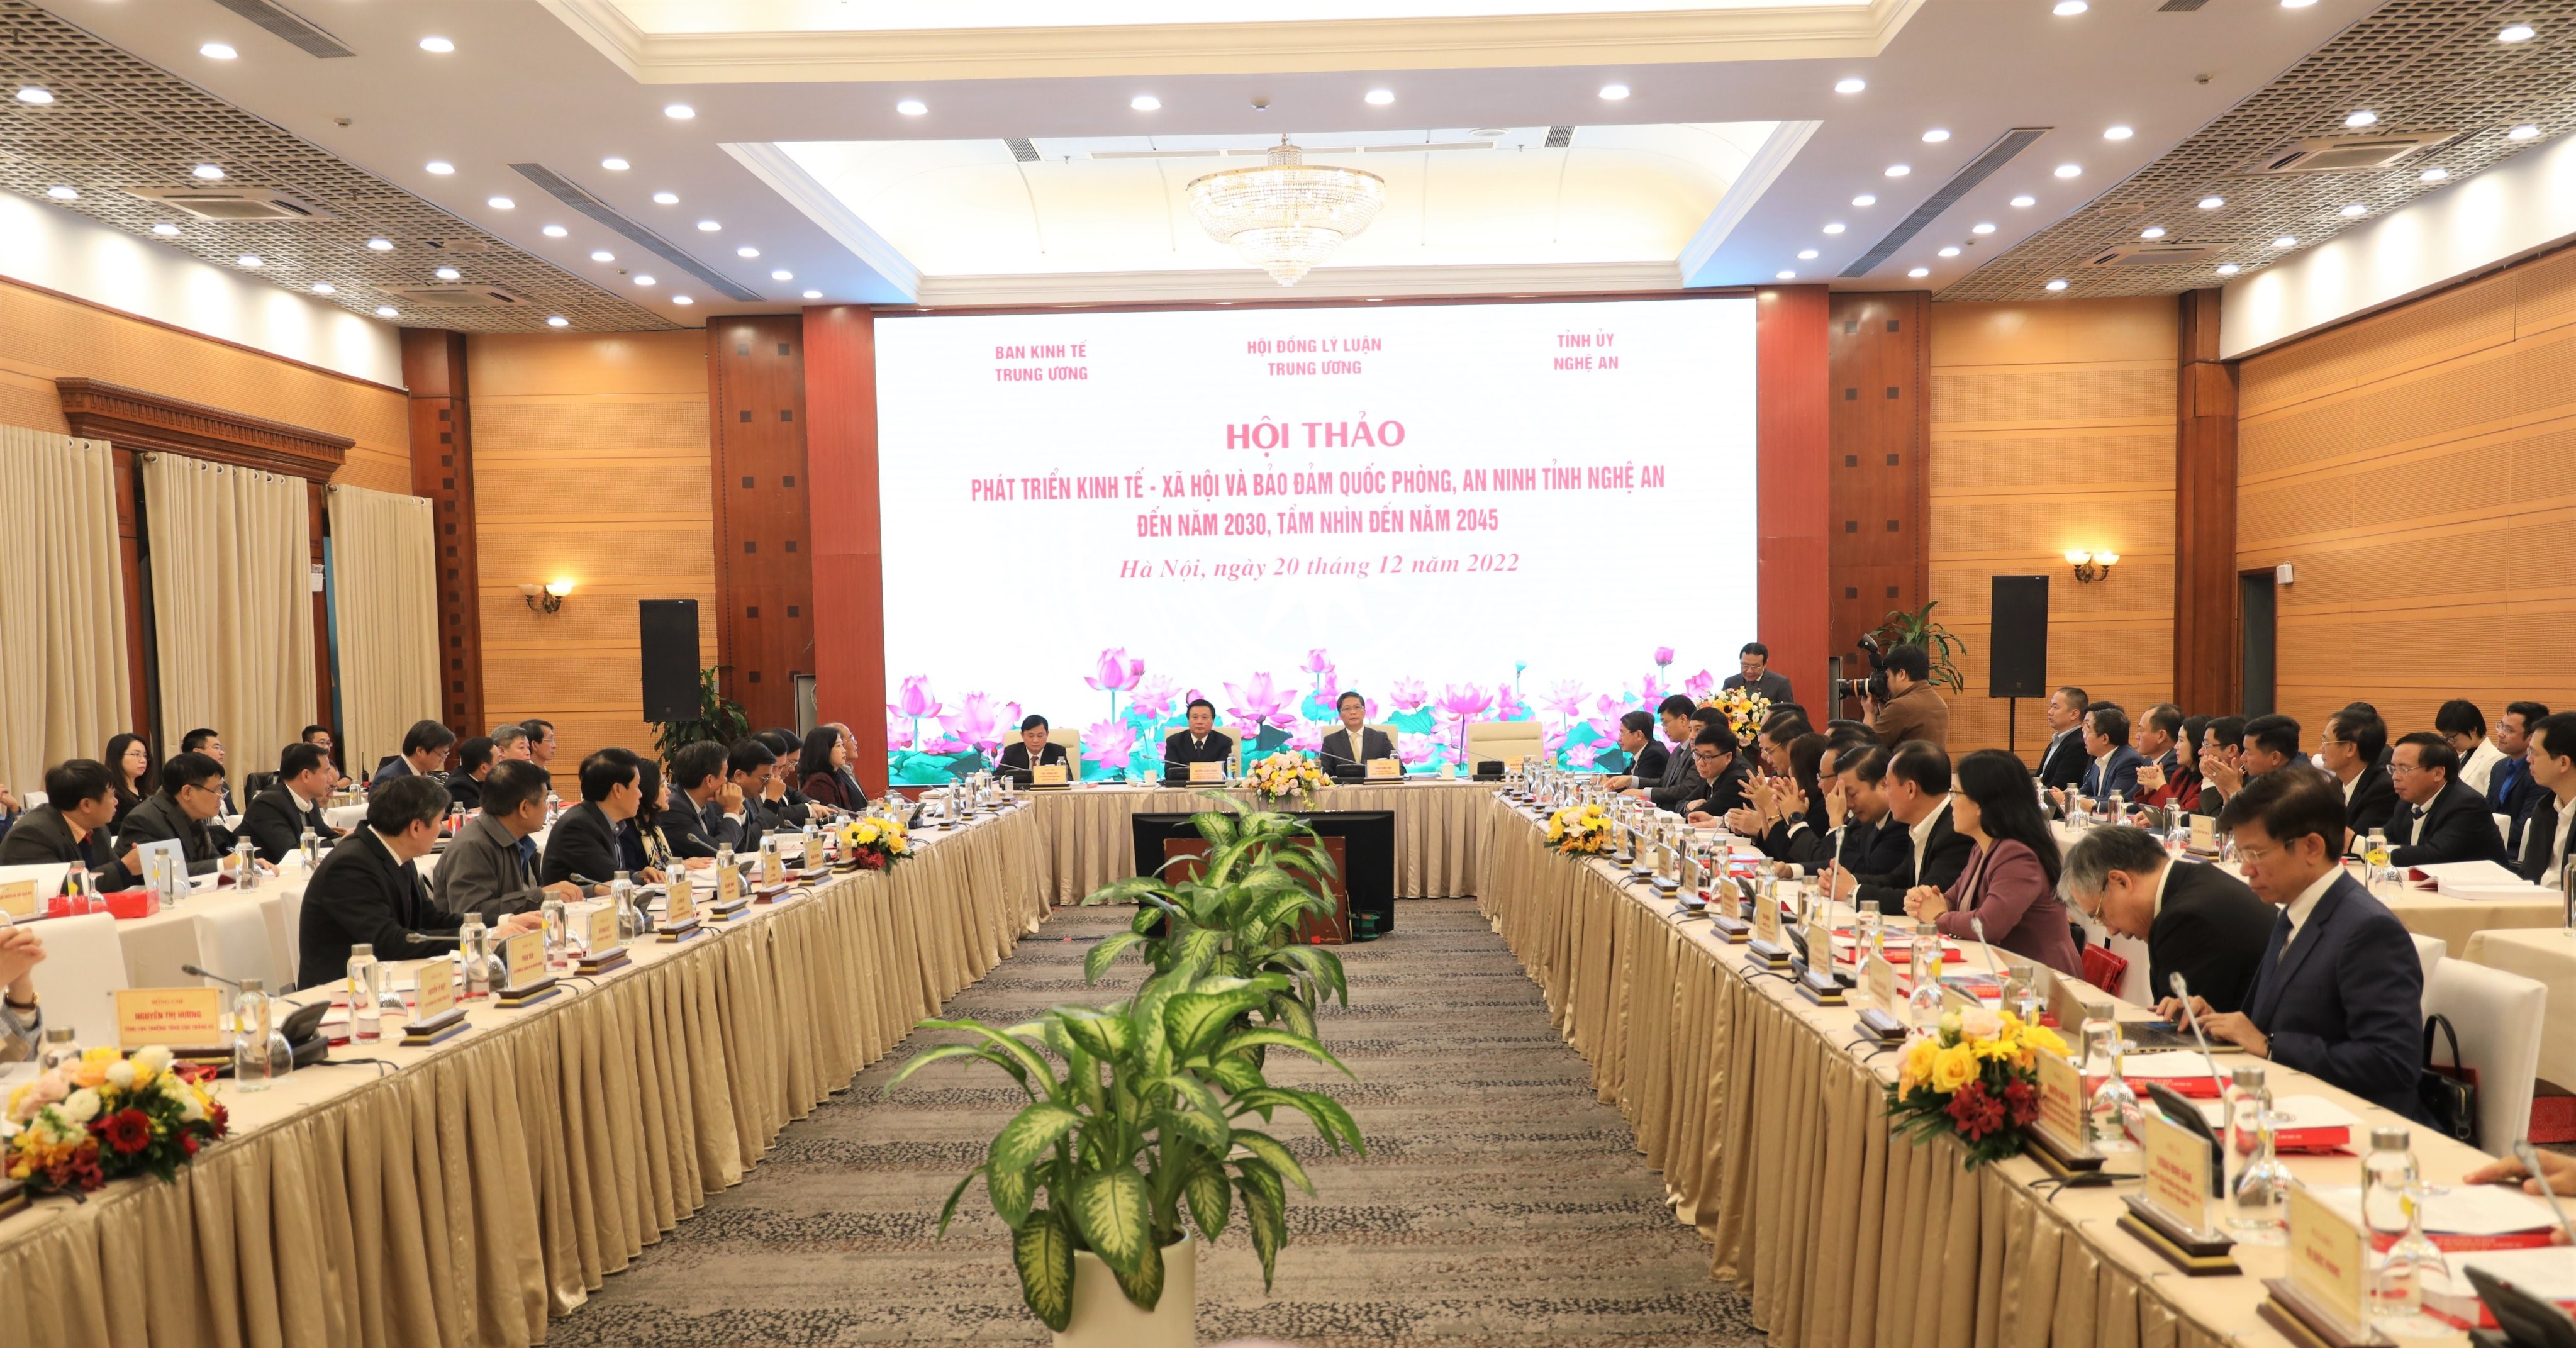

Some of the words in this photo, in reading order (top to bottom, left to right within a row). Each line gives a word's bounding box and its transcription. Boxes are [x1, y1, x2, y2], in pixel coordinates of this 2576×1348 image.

[1247, 337, 1271, 357] HỘI
[1276, 335, 1317, 353] ĐỒNG
[1322, 337, 1338, 352] LÝ
[1343, 335, 1381, 354] LUẬN
[1557, 329, 1591, 348] TỈNH
[1596, 328, 1614, 347] ỦY
[995, 346, 1025, 359] BAN
[1030, 345, 1066, 359] KINH
[1070, 340, 1087, 357] TẾ
[1268, 362, 1316, 376] TRUNG
[1322, 360, 1361, 375] ƯƠNG
[1554, 354, 1592, 372] NGHỆ
[1598, 356, 1619, 369] AN
[995, 367, 1043, 381] TRUNG
[1048, 366, 1088, 381] ƯƠNG
[1227, 415, 1289, 457] HỘI
[1302, 411, 1405, 448] THẢO
[971, 474, 1015, 501] PHÁT
[1021, 468, 1071, 500] TRIỂN
[1077, 476, 1118, 499] KINH
[1124, 468, 1144, 498] TẾ
[1162, 471, 1185, 498] XÃ
[1191, 469, 1219, 502] HỘI
[1225, 469, 1248, 497] VÀ
[1253, 463, 1288, 496] BẢO
[1293, 462, 1333, 495] ĐẢM
[1339, 463, 1386, 496] QUỐC
[1391, 464, 1458, 494] PHÒNG,
[1463, 469, 1487, 492] AN
[1493, 468, 1536, 491] NINH
[1542, 459, 1581, 490] TỈNH
[1588, 461, 1634, 494] NGHỆ
[1641, 465, 1665, 488] AN
[1137, 506, 1172, 537] ĐẾN
[1178, 509, 1218, 537] NĂM
[1224, 513, 1271, 538] 2030,
[1277, 504, 1314, 534] TẦM
[1320, 506, 1363, 533] NHÌN
[1369, 502, 1404, 533] ĐẾN
[1410, 504, 1451, 532] NĂM
[1456, 508, 1498, 531] 2045
[1119, 559, 1152, 579] Hà
[1160, 560, 1206, 582] Nội,
[1214, 559, 1266, 581] ngày
[1273, 557, 1300, 576] 20
[1307, 556, 1370, 579] tháng
[1379, 555, 1403, 574] 12
[1412, 556, 1459, 573] năm
[1467, 554, 1520, 572] 2022
[135, 1010, 164, 1020] NGUYỄN
[165, 1011, 176, 1020] THỊ
[177, 1011, 202, 1019] HƯƠNG
